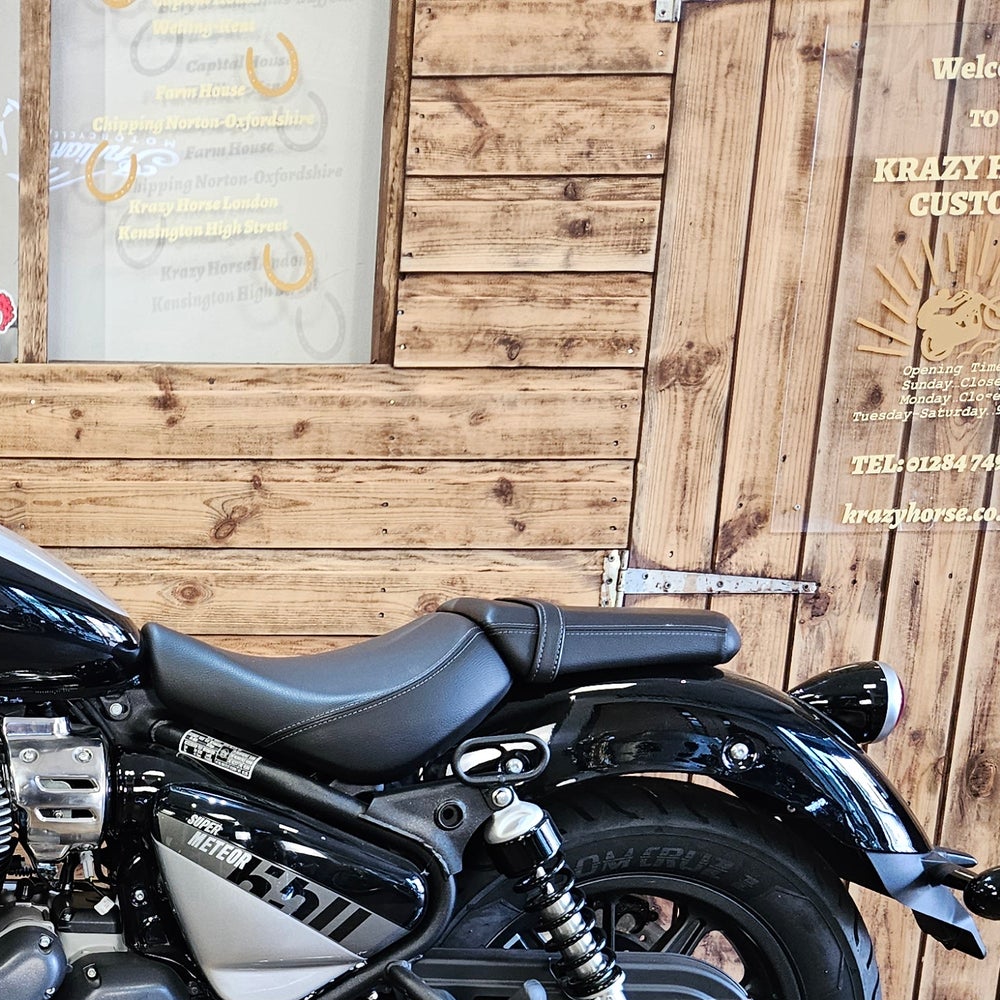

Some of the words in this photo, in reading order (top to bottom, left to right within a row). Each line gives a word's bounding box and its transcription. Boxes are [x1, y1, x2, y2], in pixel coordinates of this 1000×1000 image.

[93, 116, 163, 136] Chipping
[969, 109, 999, 127] TO
[873, 156, 985, 183] KRAZY
[128, 198, 174, 216] Krazy
[176, 196, 220, 212] Horse
[222, 194, 279, 210] London
[118, 222, 202, 243] Kensington
[204, 221, 241, 240] High
[242, 218, 288, 235] Street
[903, 363, 963, 378] Opening
[187, 813, 224, 835] SUPER
[187, 830, 252, 870] METEOR
